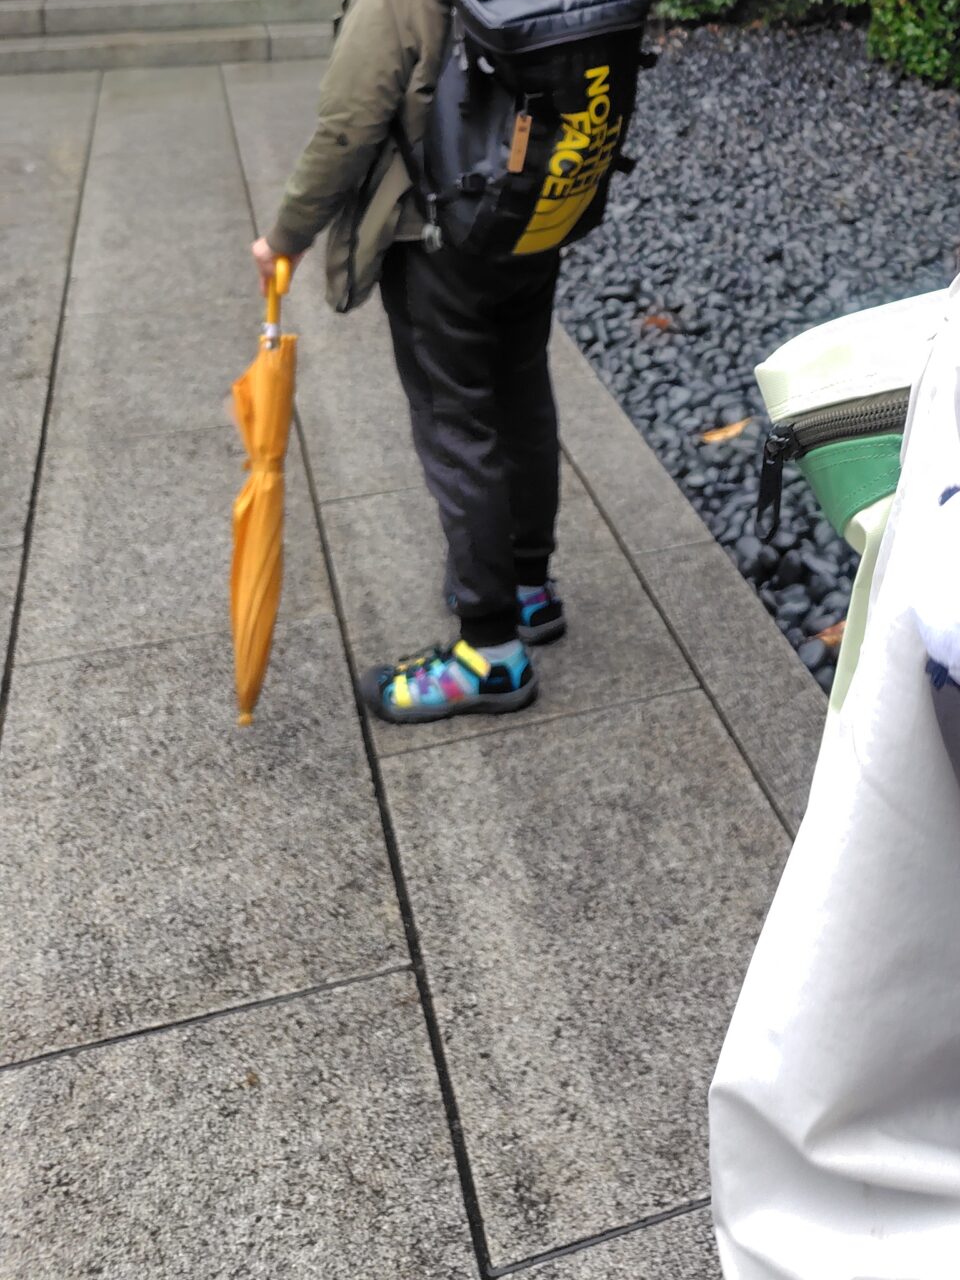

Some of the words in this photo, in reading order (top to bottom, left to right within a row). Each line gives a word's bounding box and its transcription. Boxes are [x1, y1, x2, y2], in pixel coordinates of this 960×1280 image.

[542, 111, 591, 198] FACE
[569, 65, 610, 195] NORTH
[597, 114, 623, 182] THE
